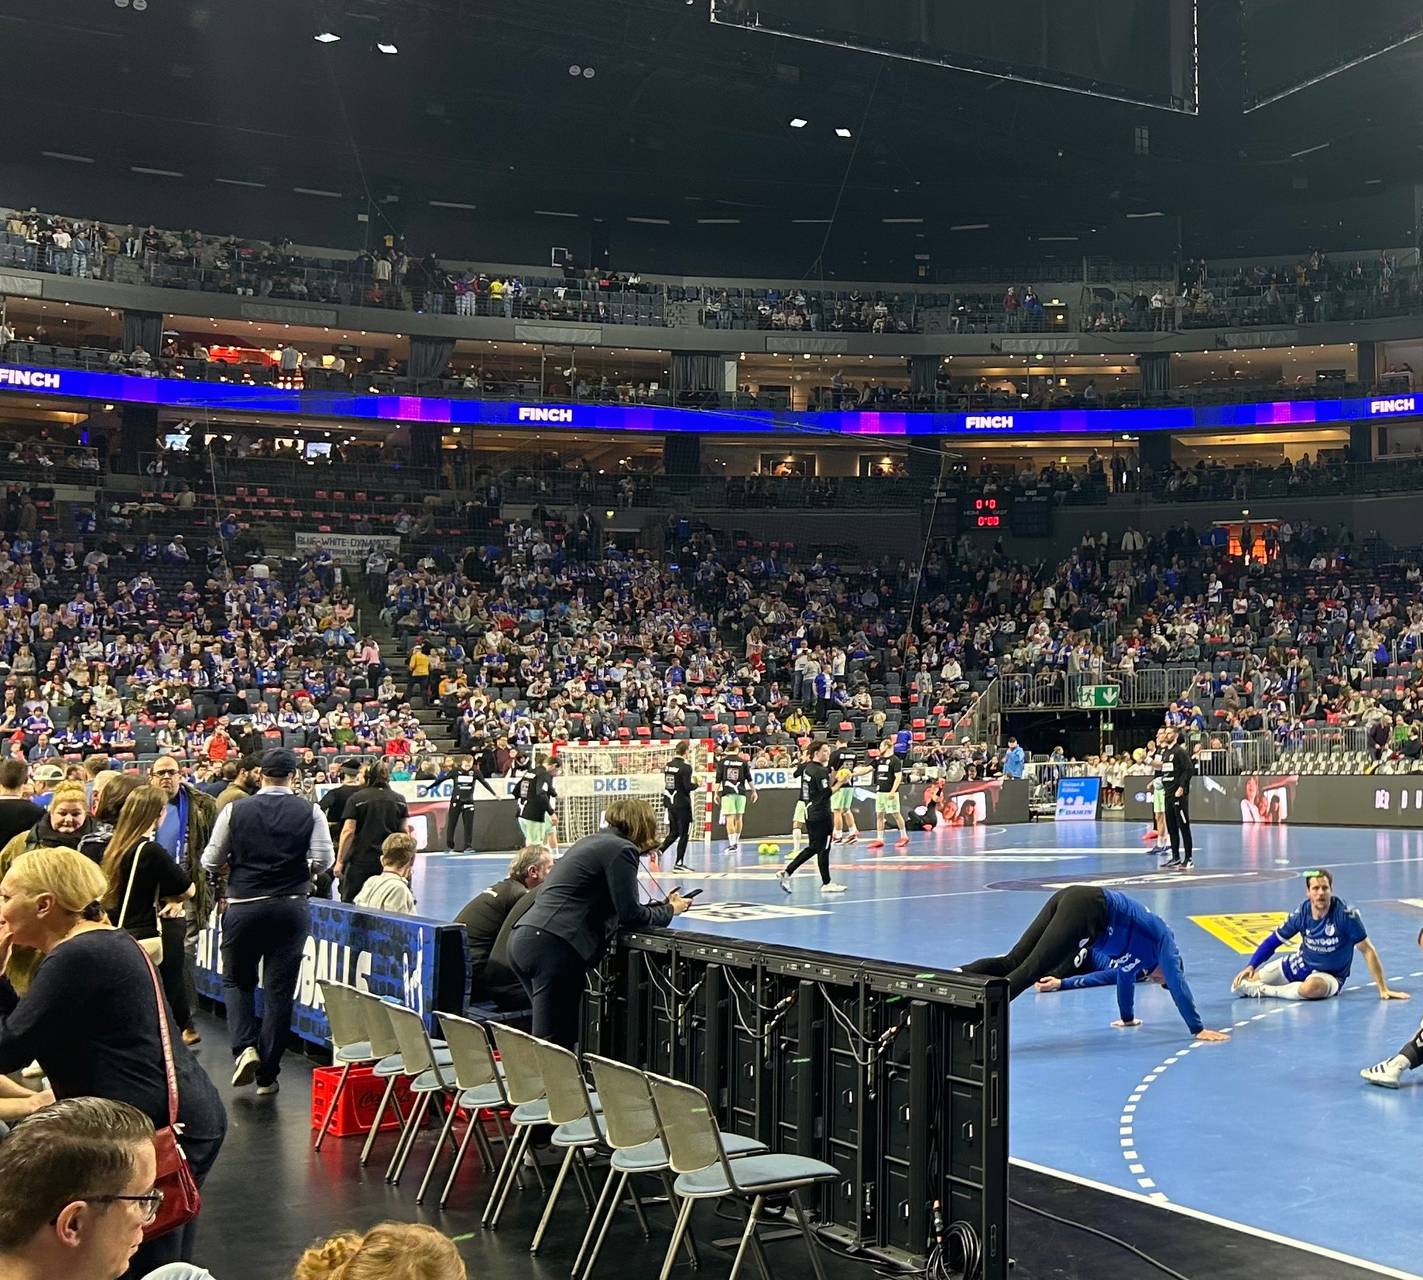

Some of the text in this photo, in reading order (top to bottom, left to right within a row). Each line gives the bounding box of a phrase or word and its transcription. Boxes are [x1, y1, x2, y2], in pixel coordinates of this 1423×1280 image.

[0, 367, 61, 389] FINCH
[1371, 397, 1415, 414] FINCH
[518, 406, 573, 422] FINCH
[965, 415, 1014, 429] FINCH
[593, 777, 628, 793] DKB
[753, 771, 786, 785] DKB
